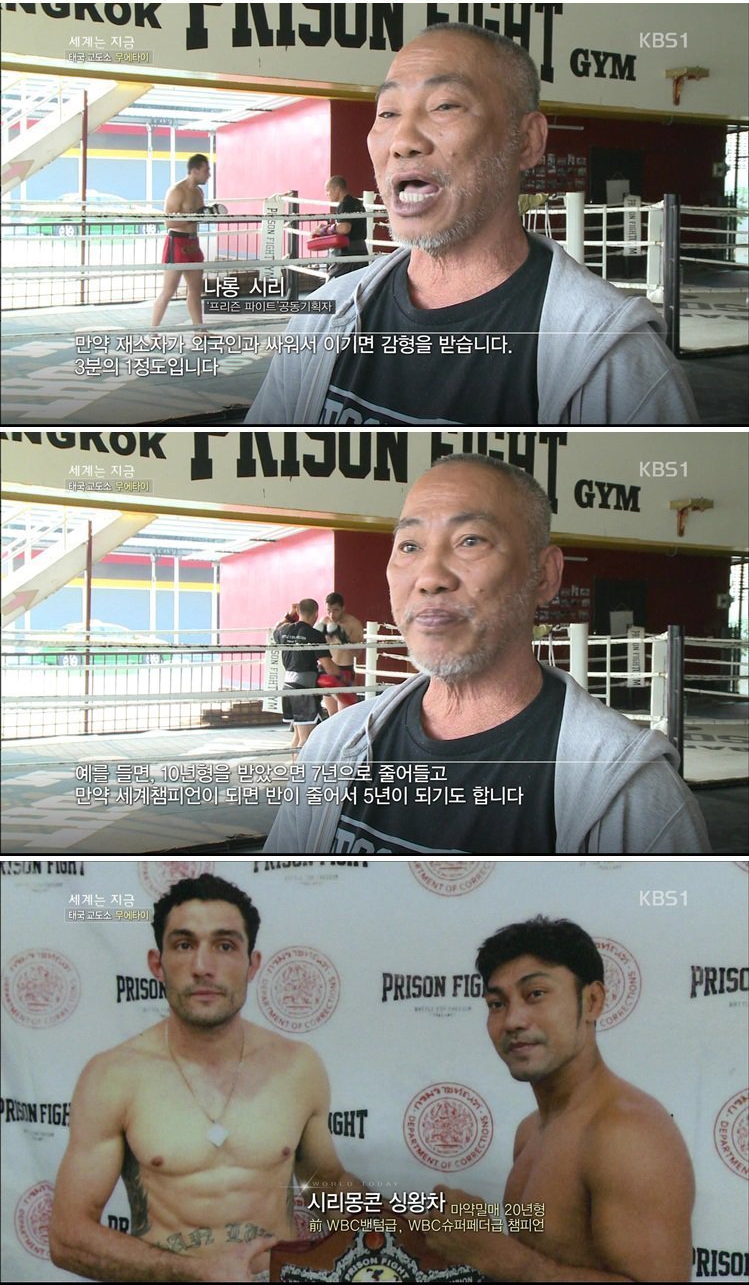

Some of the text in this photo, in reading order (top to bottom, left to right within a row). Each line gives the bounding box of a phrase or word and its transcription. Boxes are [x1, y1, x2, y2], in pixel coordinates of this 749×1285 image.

[570, 48, 637, 81] GYM
[574, 479, 641, 513] GYM
[381, 972, 446, 1003] PRISON
[600, 970, 638, 1028] CORRECTIONS
[407, 1115, 489, 1169] DEPARTMENT OF CORRECTIONS
[344, 1257, 410, 1280] PRISON FIGHT
